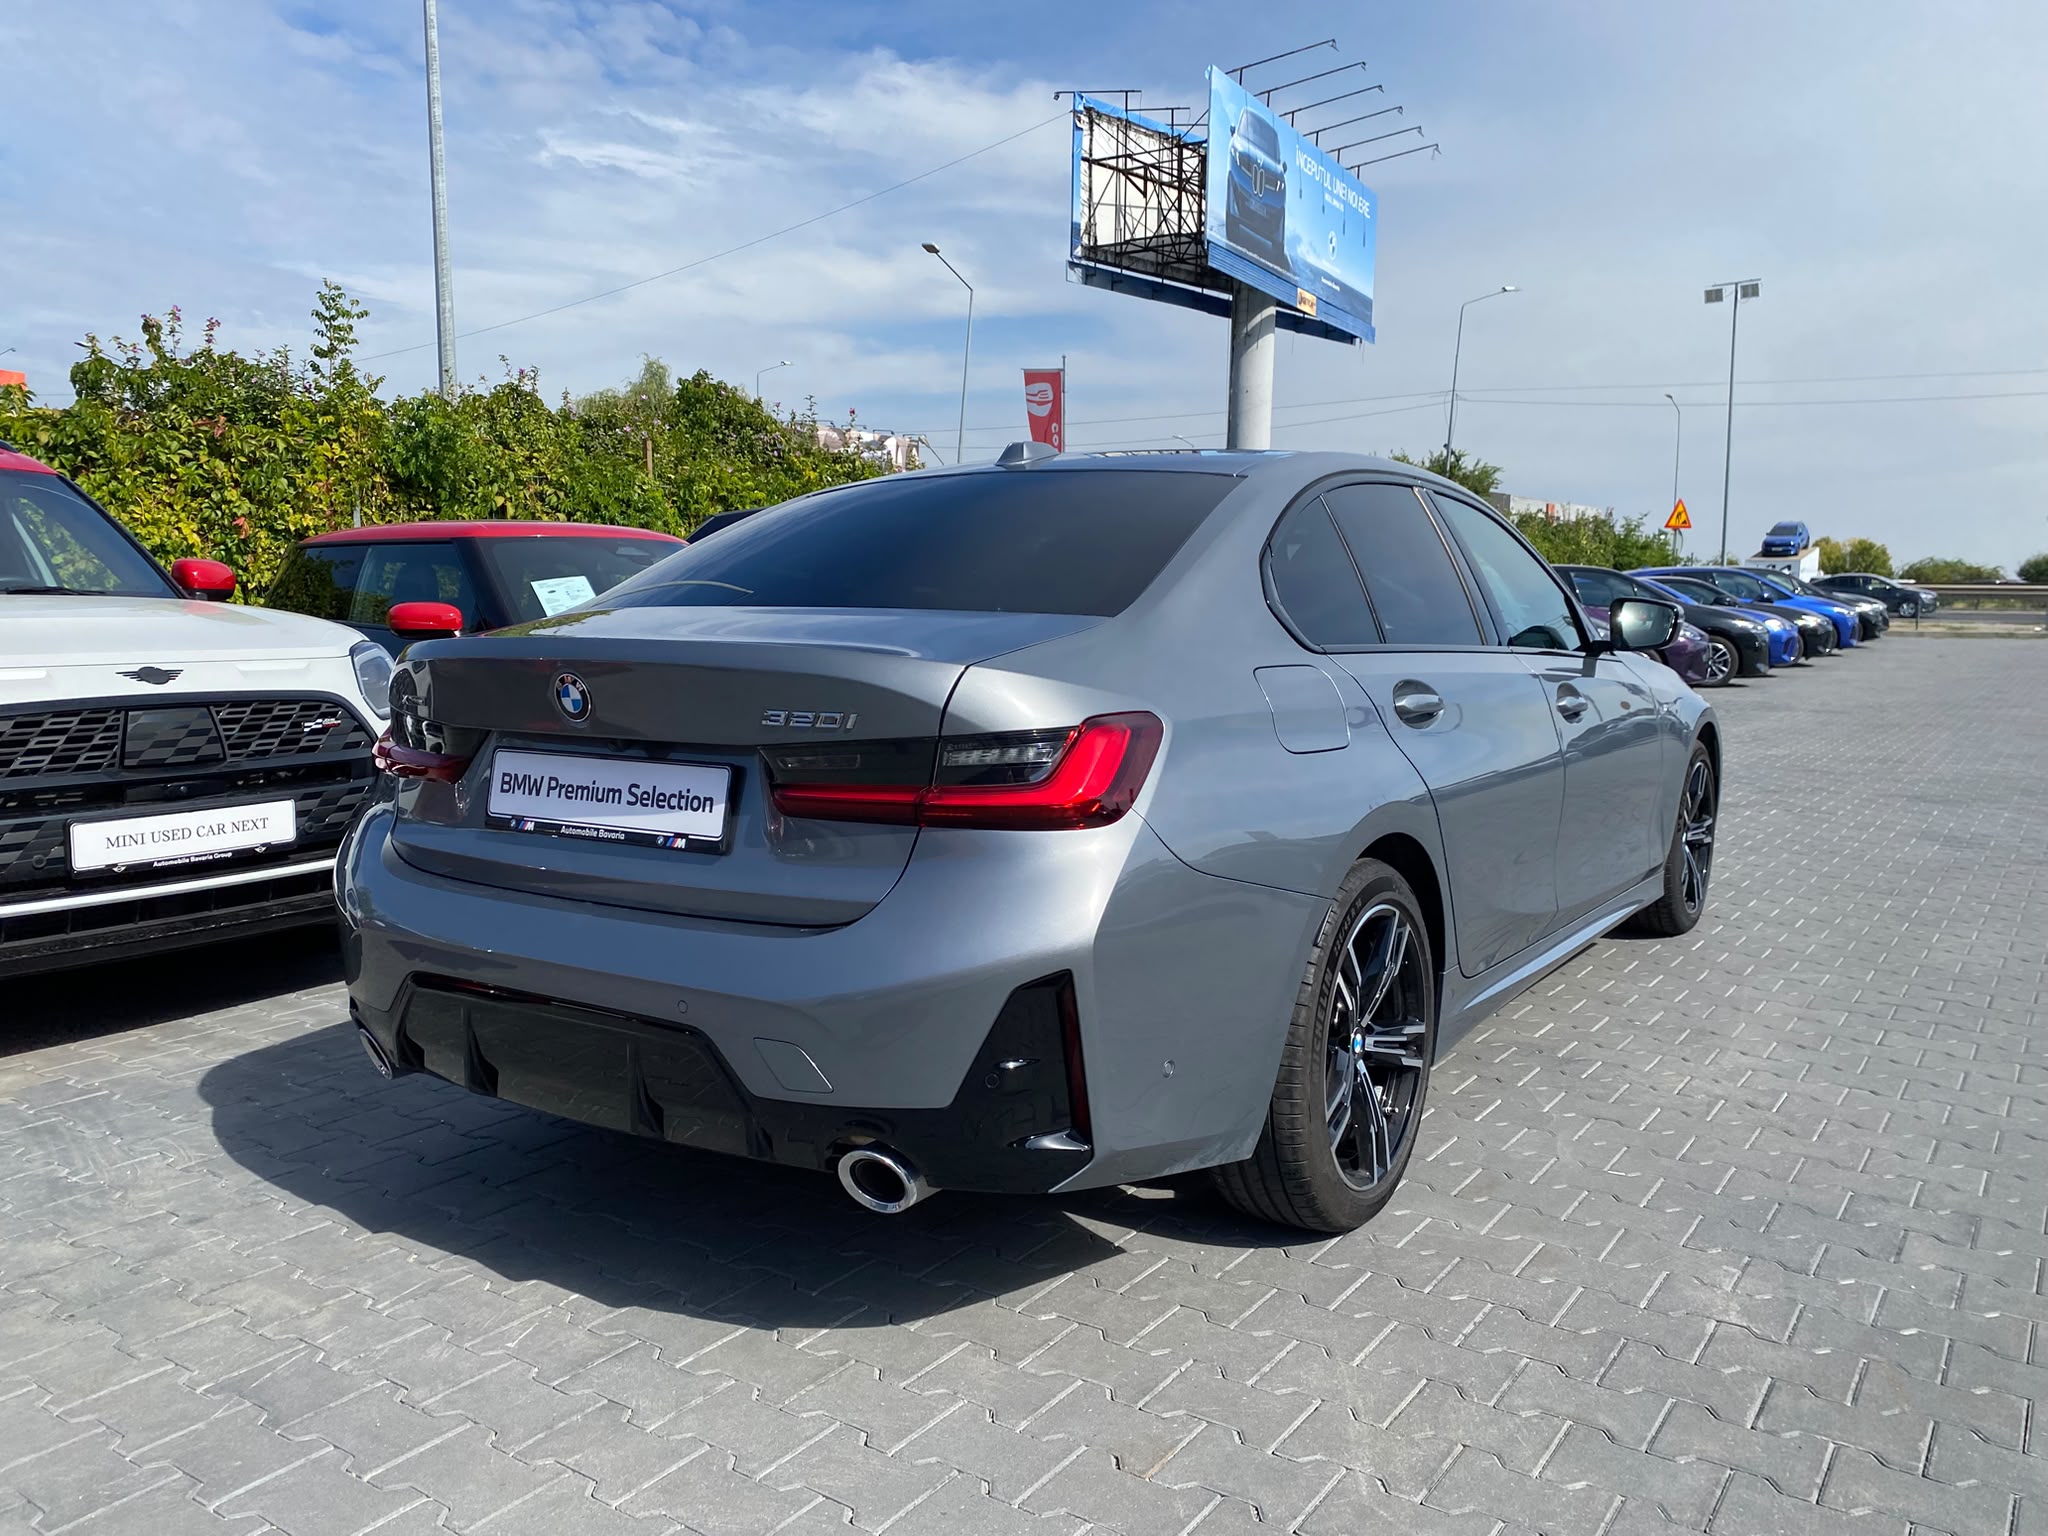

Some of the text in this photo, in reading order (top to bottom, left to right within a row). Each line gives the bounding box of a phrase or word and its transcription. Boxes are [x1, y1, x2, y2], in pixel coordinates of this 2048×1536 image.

[500, 772, 714, 814] BMW Premium Selection
[105, 817, 269, 849] MINI USED CAR NEXT
[560, 826, 625, 841] Automobile Bavaria
[213, 851, 233, 859] Group
[1310, 967, 1334, 1084] ICHELIN
